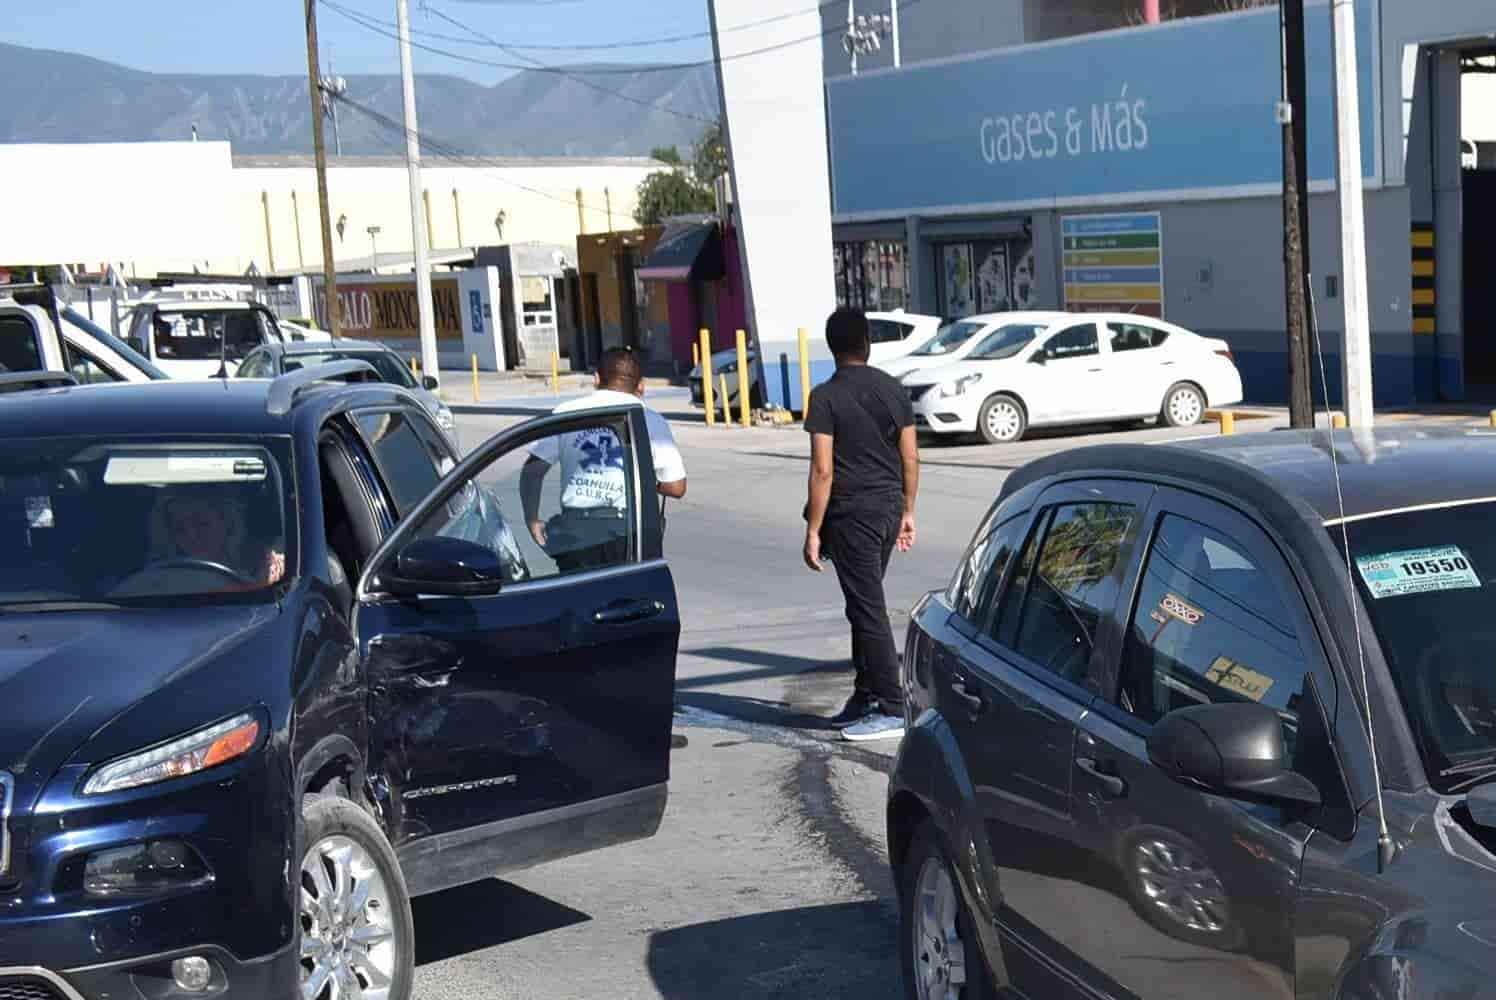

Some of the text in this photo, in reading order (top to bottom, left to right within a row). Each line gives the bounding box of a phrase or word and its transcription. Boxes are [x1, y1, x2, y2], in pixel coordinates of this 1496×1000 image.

[980, 81, 1149, 165] Gases & Más
[1400, 557, 1468, 576] 19550
